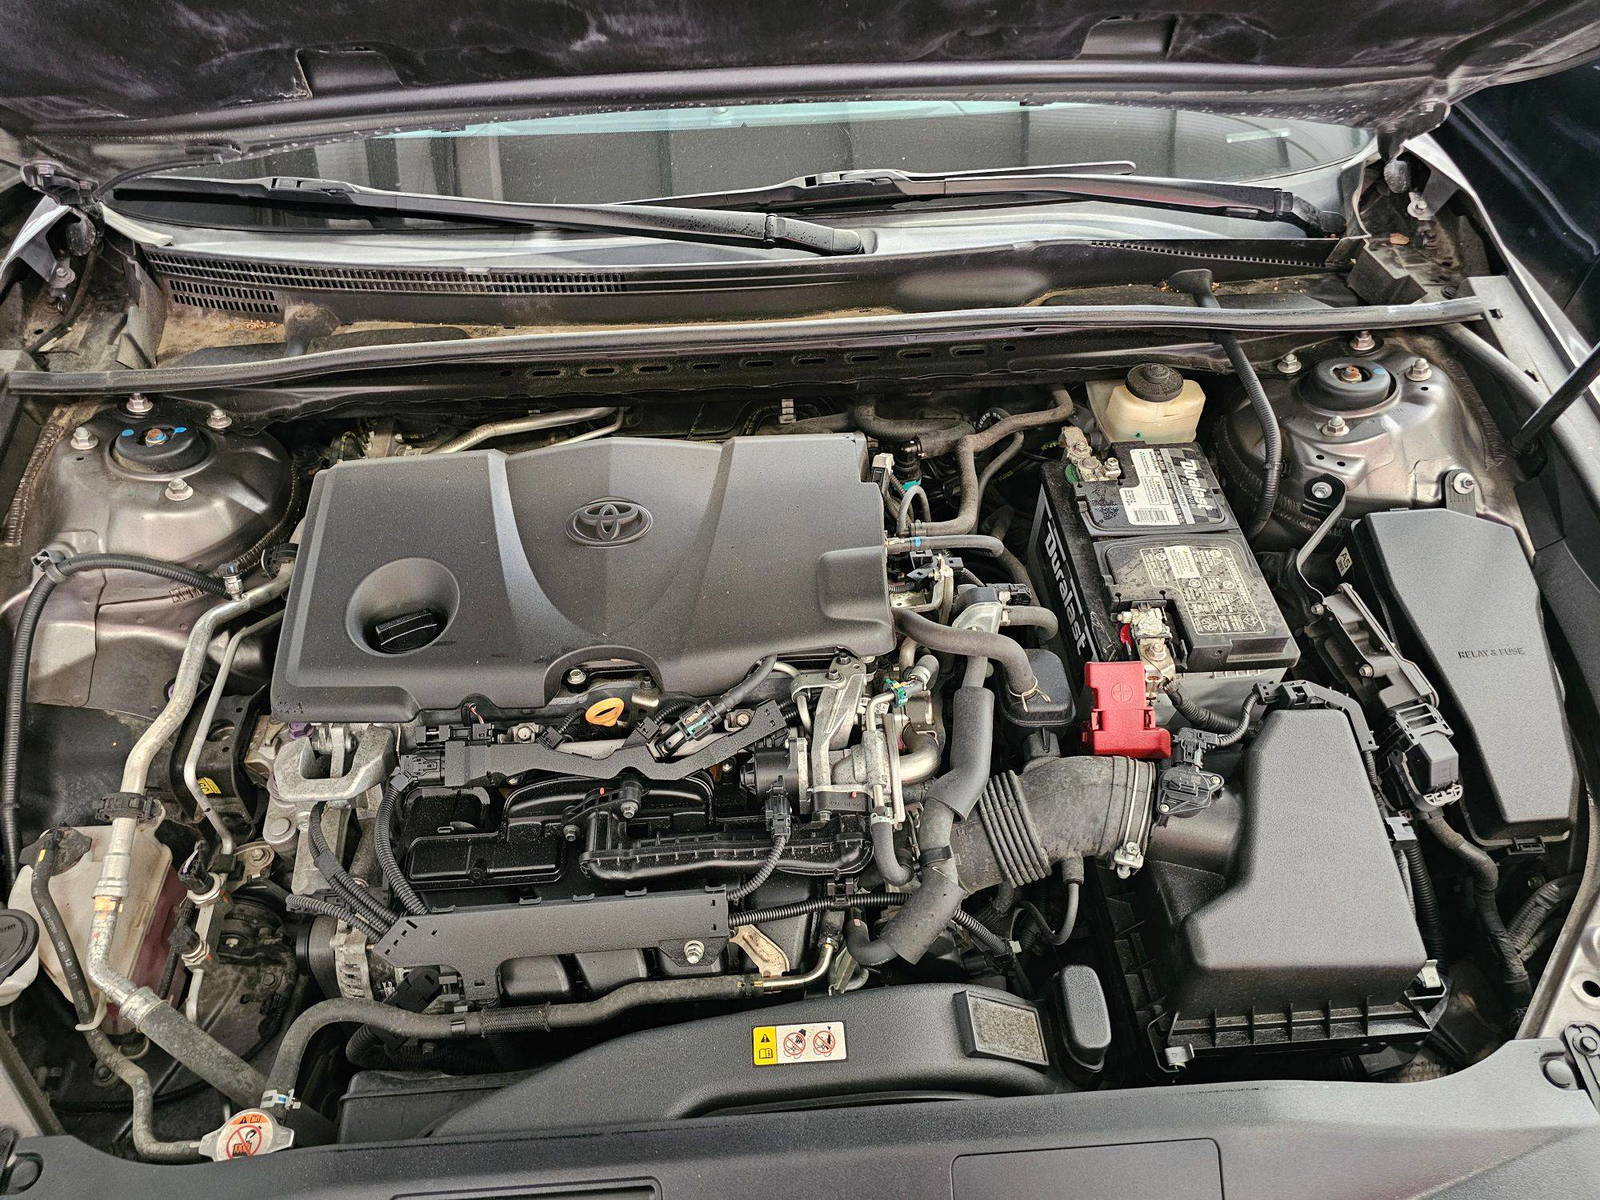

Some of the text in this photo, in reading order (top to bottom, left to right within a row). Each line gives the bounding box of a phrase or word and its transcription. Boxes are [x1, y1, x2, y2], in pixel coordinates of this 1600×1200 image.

[1180, 460, 1213, 511] Duralast
[1045, 533, 1086, 656] Duralast
[1457, 647, 1525, 659] RELAY & FUSE
